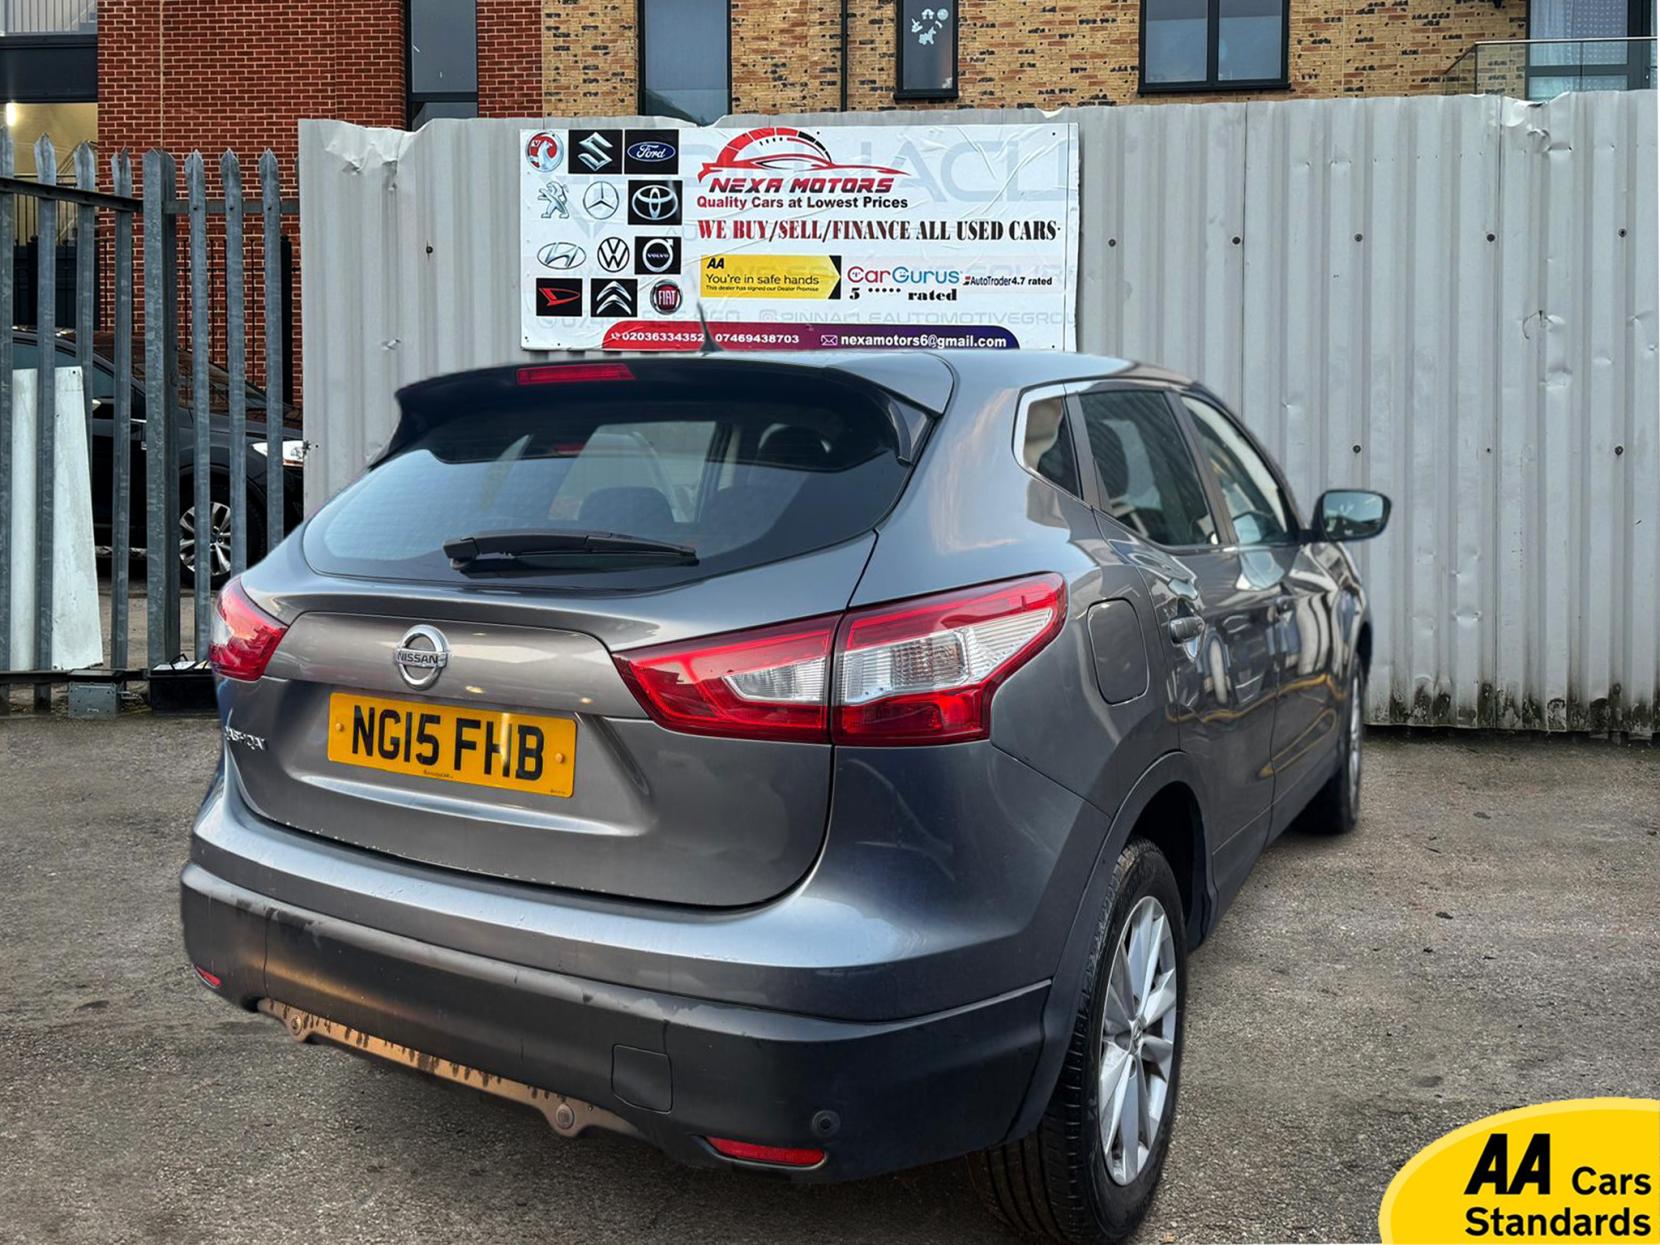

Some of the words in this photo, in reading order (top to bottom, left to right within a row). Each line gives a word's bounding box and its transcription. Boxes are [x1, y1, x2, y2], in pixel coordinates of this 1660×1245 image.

[636, 144, 666, 159] Ford
[708, 178, 784, 193] NEXA
[789, 178, 895, 193] MOTORS
[697, 196, 747, 210] Quality
[751, 196, 784, 208] Cars
[788, 197, 802, 208] at
[807, 196, 858, 208] Lowest
[863, 196, 908, 208] Prices
[697, 219, 727, 240] WE
[733, 219, 911, 242] BUY/SELL/FINANCE
[915, 221, 951, 240] ALL
[956, 220, 1004, 240] USED
[1009, 220, 1057, 241] CARS
[706, 257, 725, 269] AA
[706, 273, 741, 284] You're
[744, 274, 754, 284] in
[757, 274, 782, 285] safe
[784, 275, 820, 285] hands
[847, 266, 960, 284] CarGurus
[1011, 276, 1026, 285] 4.7
[1028, 277, 1053, 286] rated
[658, 290, 677, 306] FIAT
[849, 288, 861, 300] 5
[907, 288, 958, 301] rated
[622, 332, 705, 342] 02036334352
[714, 333, 800, 344] 07469438703
[841, 334, 1007, 349] nexamotors6@gmail.com
[397, 651, 439, 664] NISSAN
[351, 704, 440, 767] NG15
[453, 716, 545, 782] FHB
